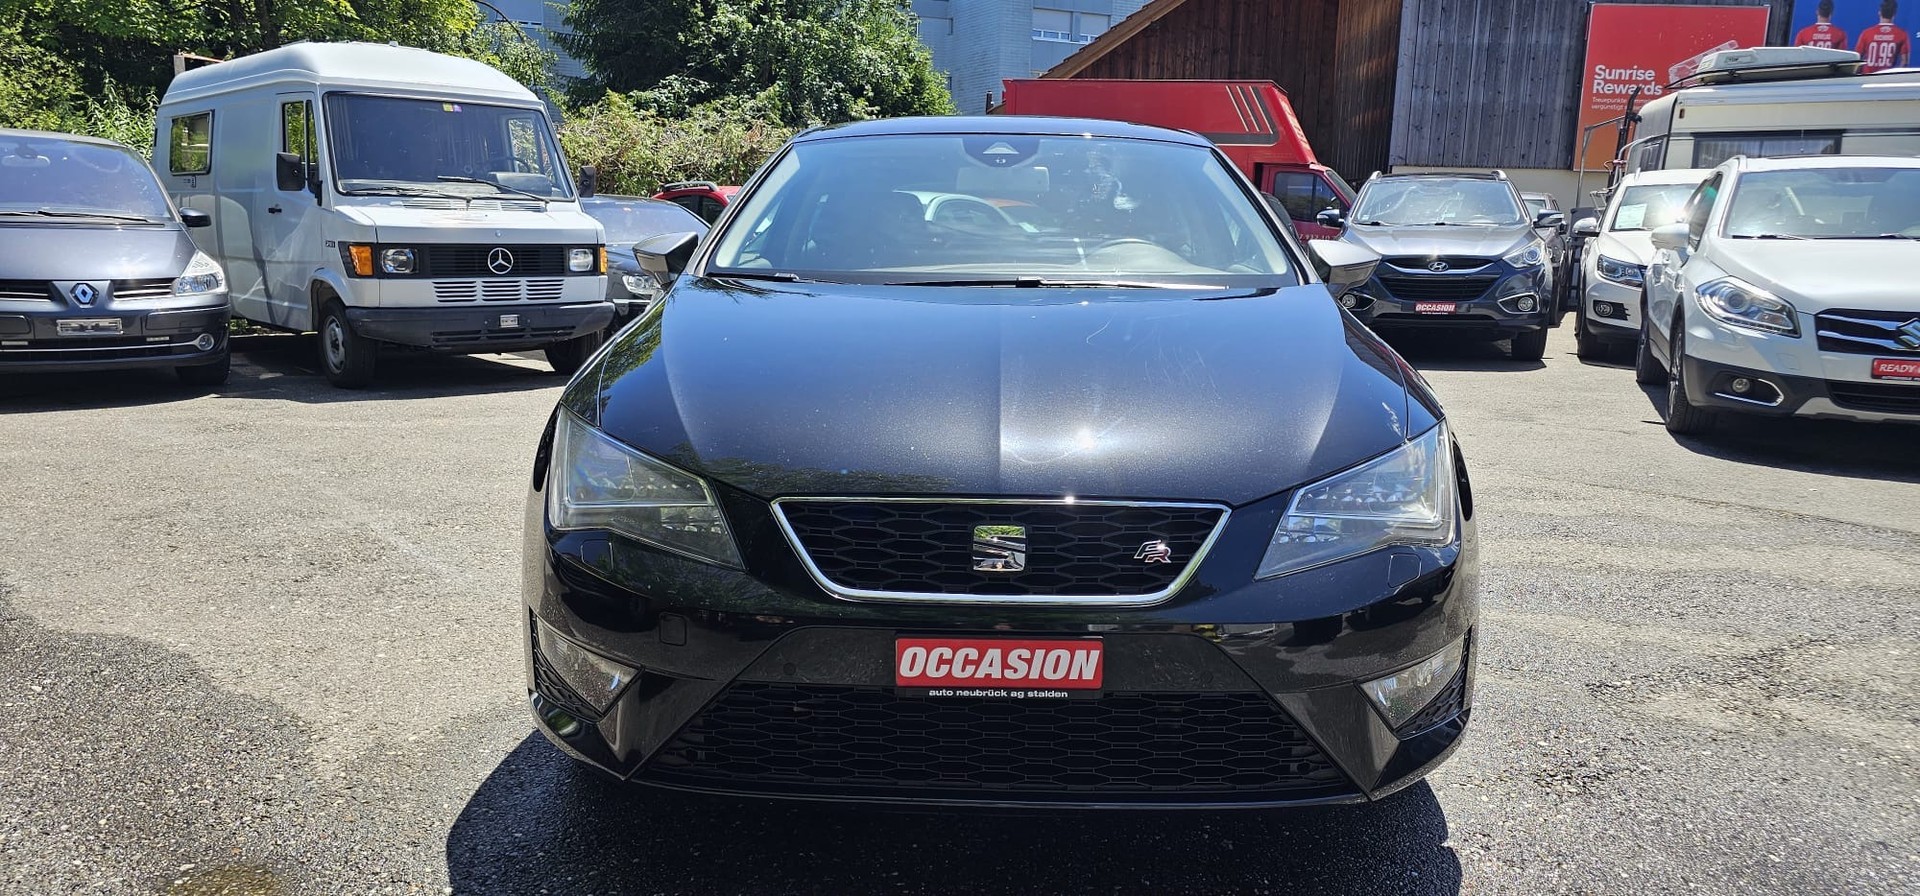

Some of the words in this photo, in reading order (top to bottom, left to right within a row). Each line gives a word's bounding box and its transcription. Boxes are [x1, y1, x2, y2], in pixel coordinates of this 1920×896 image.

[1867, 42, 1897, 67] 0.99
[1594, 65, 1656, 81] Sunrise
[1415, 304, 1456, 312] OCCASION
[1879, 363, 1917, 373] READY
[899, 646, 1100, 680] OCCASION
[929, 689, 954, 697] auto
[956, 689, 1008, 698] neubrück
[1010, 691, 1025, 699] ag
[1027, 690, 1068, 698] stalden
